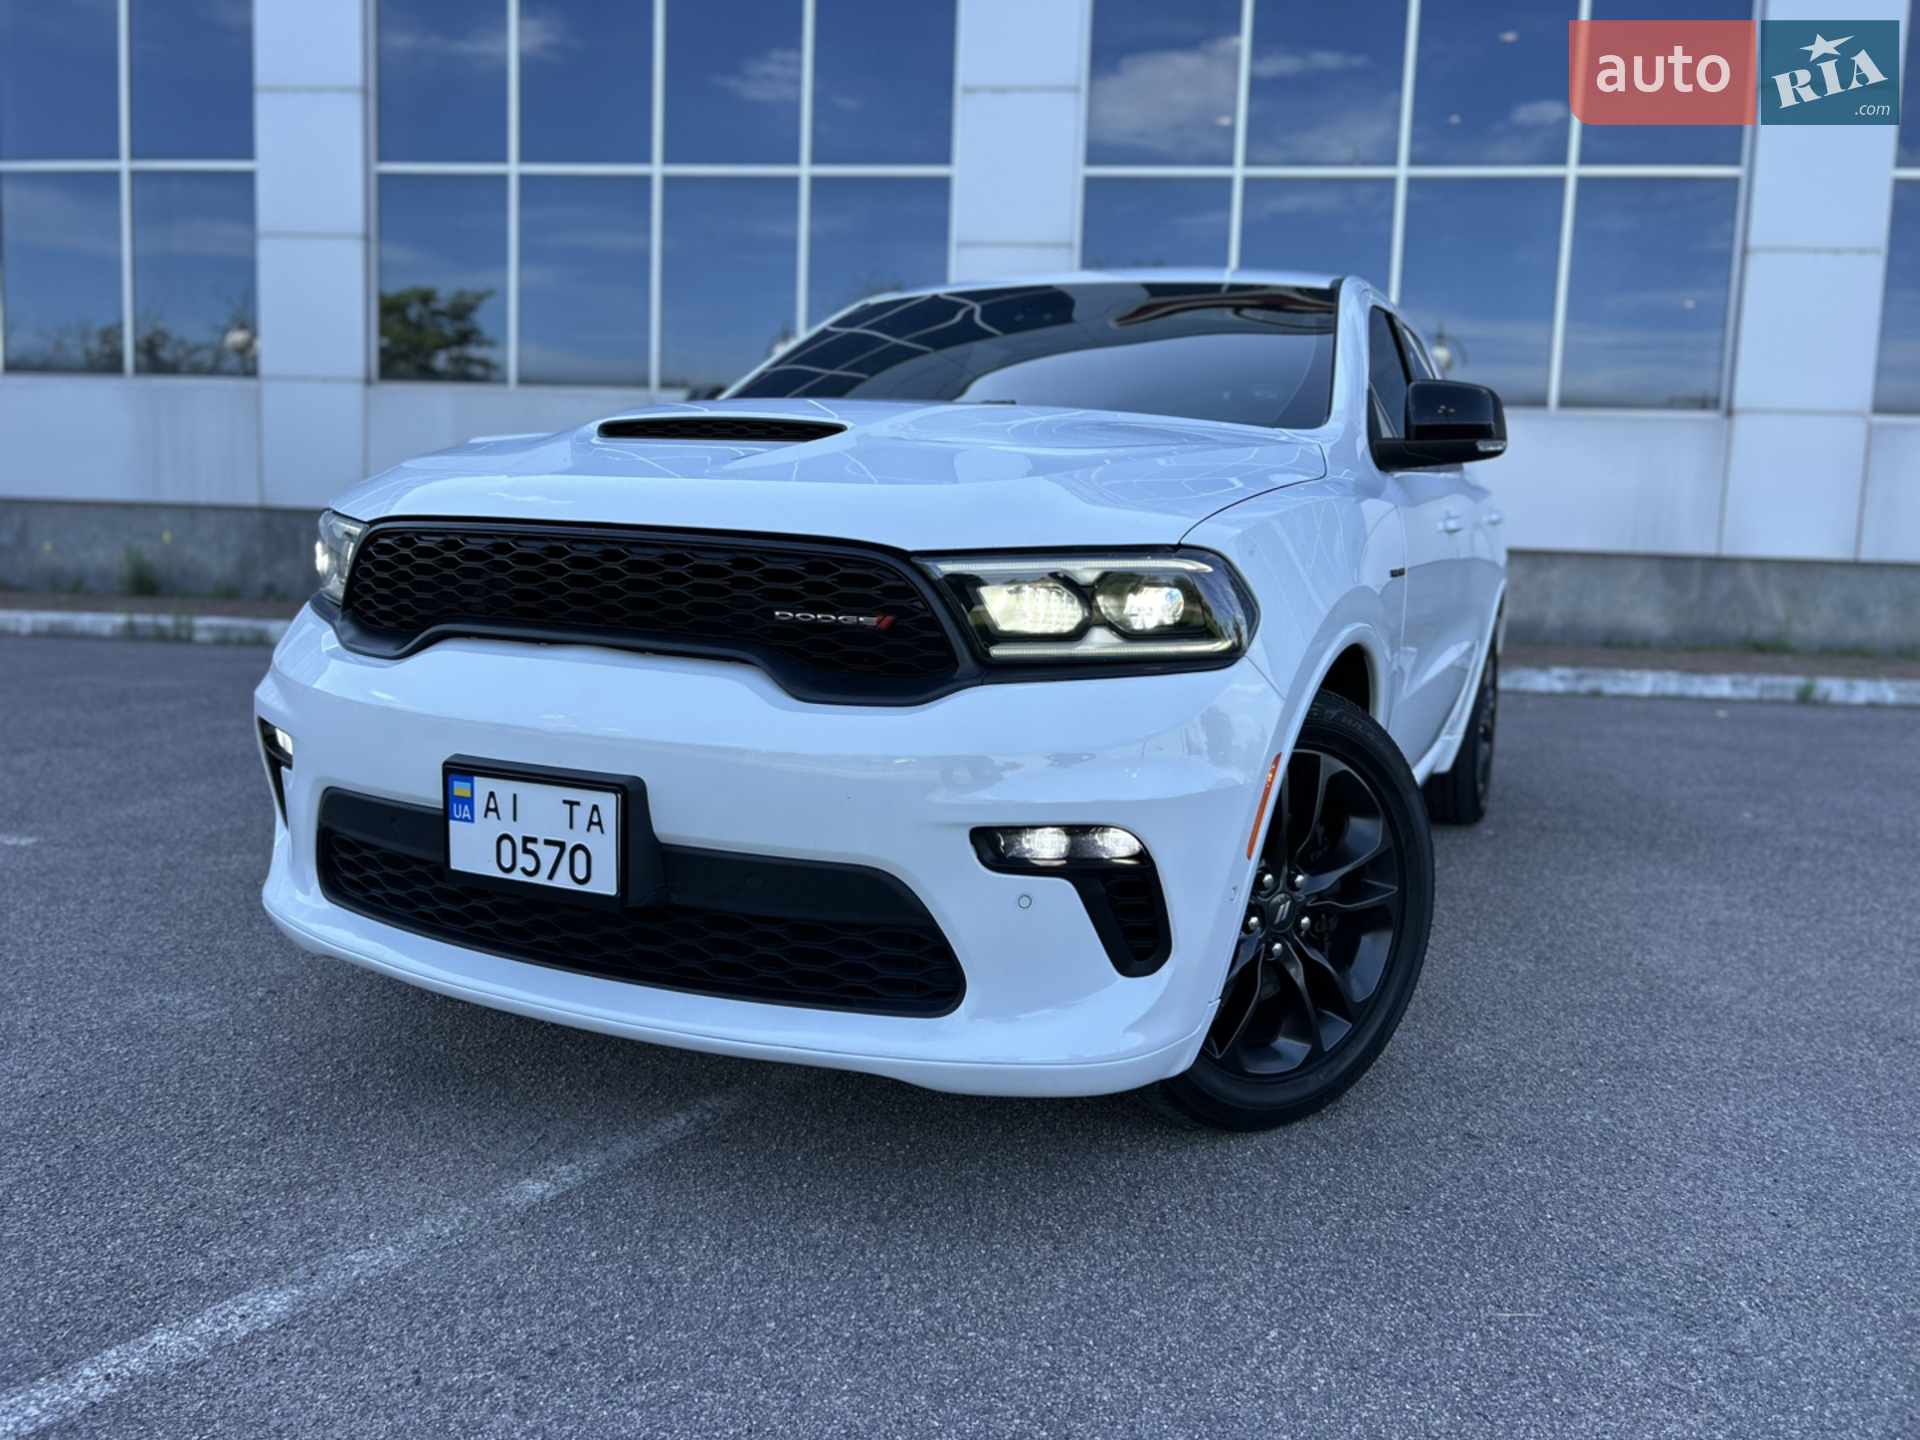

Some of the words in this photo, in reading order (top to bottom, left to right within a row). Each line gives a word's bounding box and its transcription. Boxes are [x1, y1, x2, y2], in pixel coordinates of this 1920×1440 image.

[774, 610, 878, 626] DODGE
[453, 804, 472, 820] UA
[483, 791, 517, 822] AI
[562, 799, 605, 835] TA
[495, 832, 592, 886] 0570
